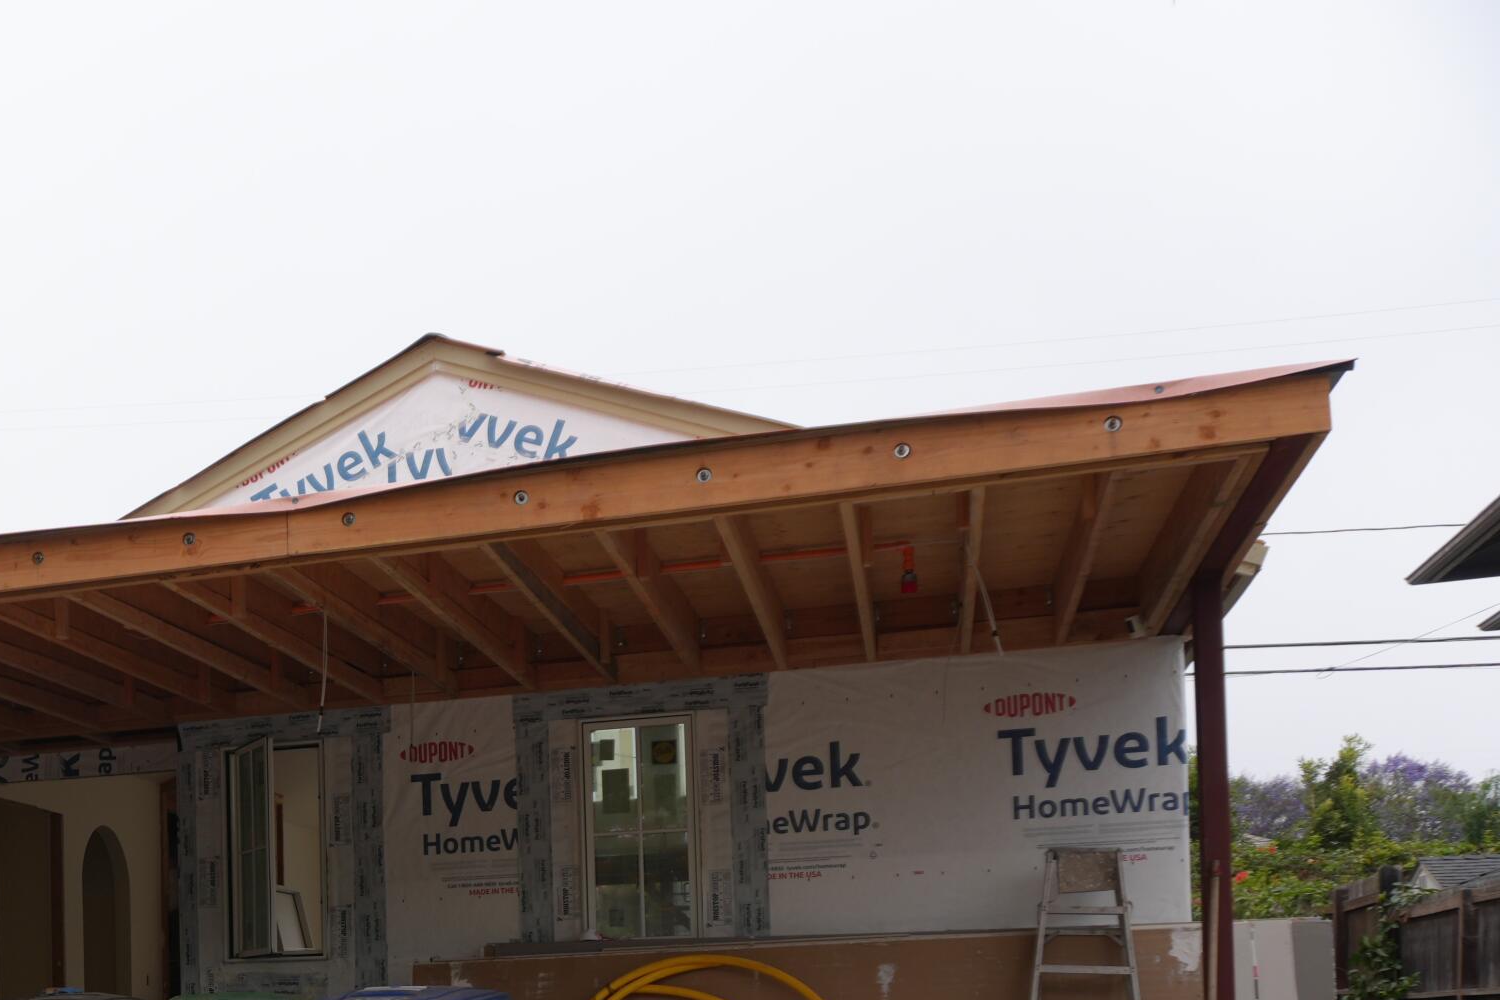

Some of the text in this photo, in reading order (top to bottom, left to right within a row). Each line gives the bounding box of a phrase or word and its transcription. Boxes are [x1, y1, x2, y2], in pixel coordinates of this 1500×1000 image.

[995, 692, 1065, 718] DUPONT
[409, 741, 466, 764] DUPONT
[997, 715, 1188, 789] Tyvek
[764, 740, 865, 793] vek
[766, 808, 872, 836] eWrap
[422, 827, 519, 856] HomeW
